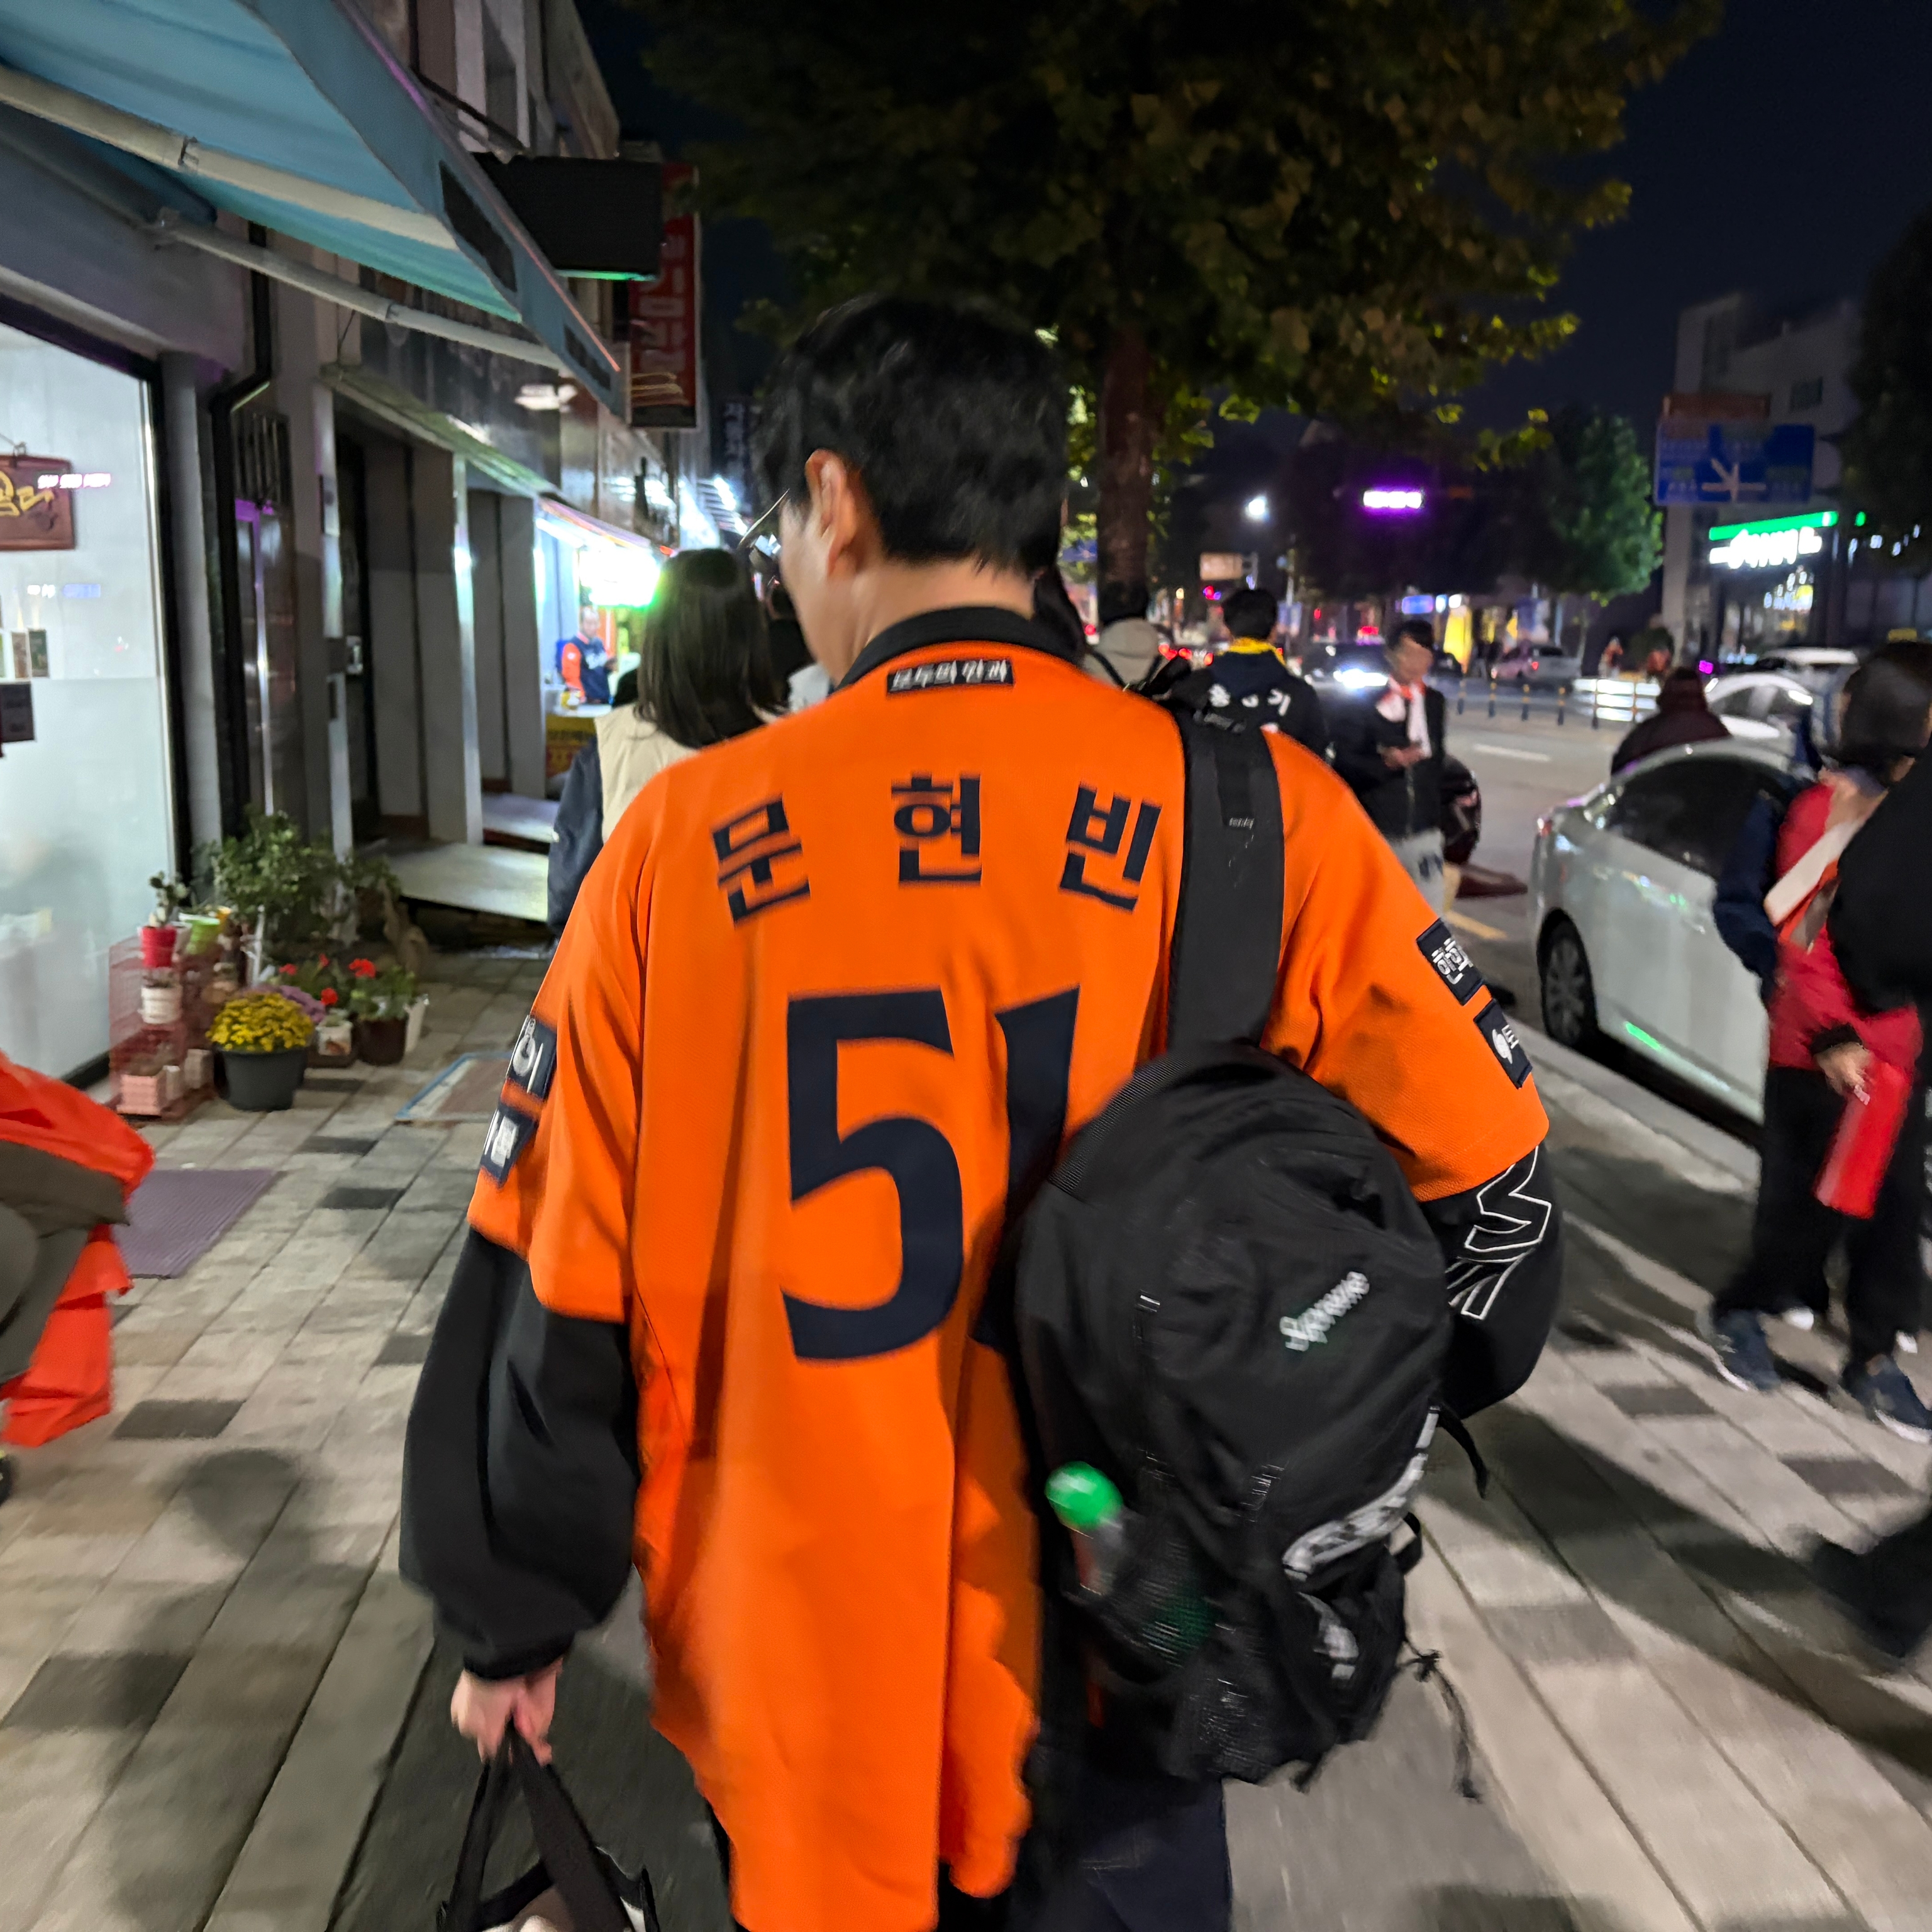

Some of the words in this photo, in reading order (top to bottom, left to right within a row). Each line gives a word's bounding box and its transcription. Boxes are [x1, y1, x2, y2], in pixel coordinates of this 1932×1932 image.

[711, 773, 1162, 924] 문현빈
[780, 984, 1079, 1360] 51
[1279, 1271, 1370, 1352] Supreme
